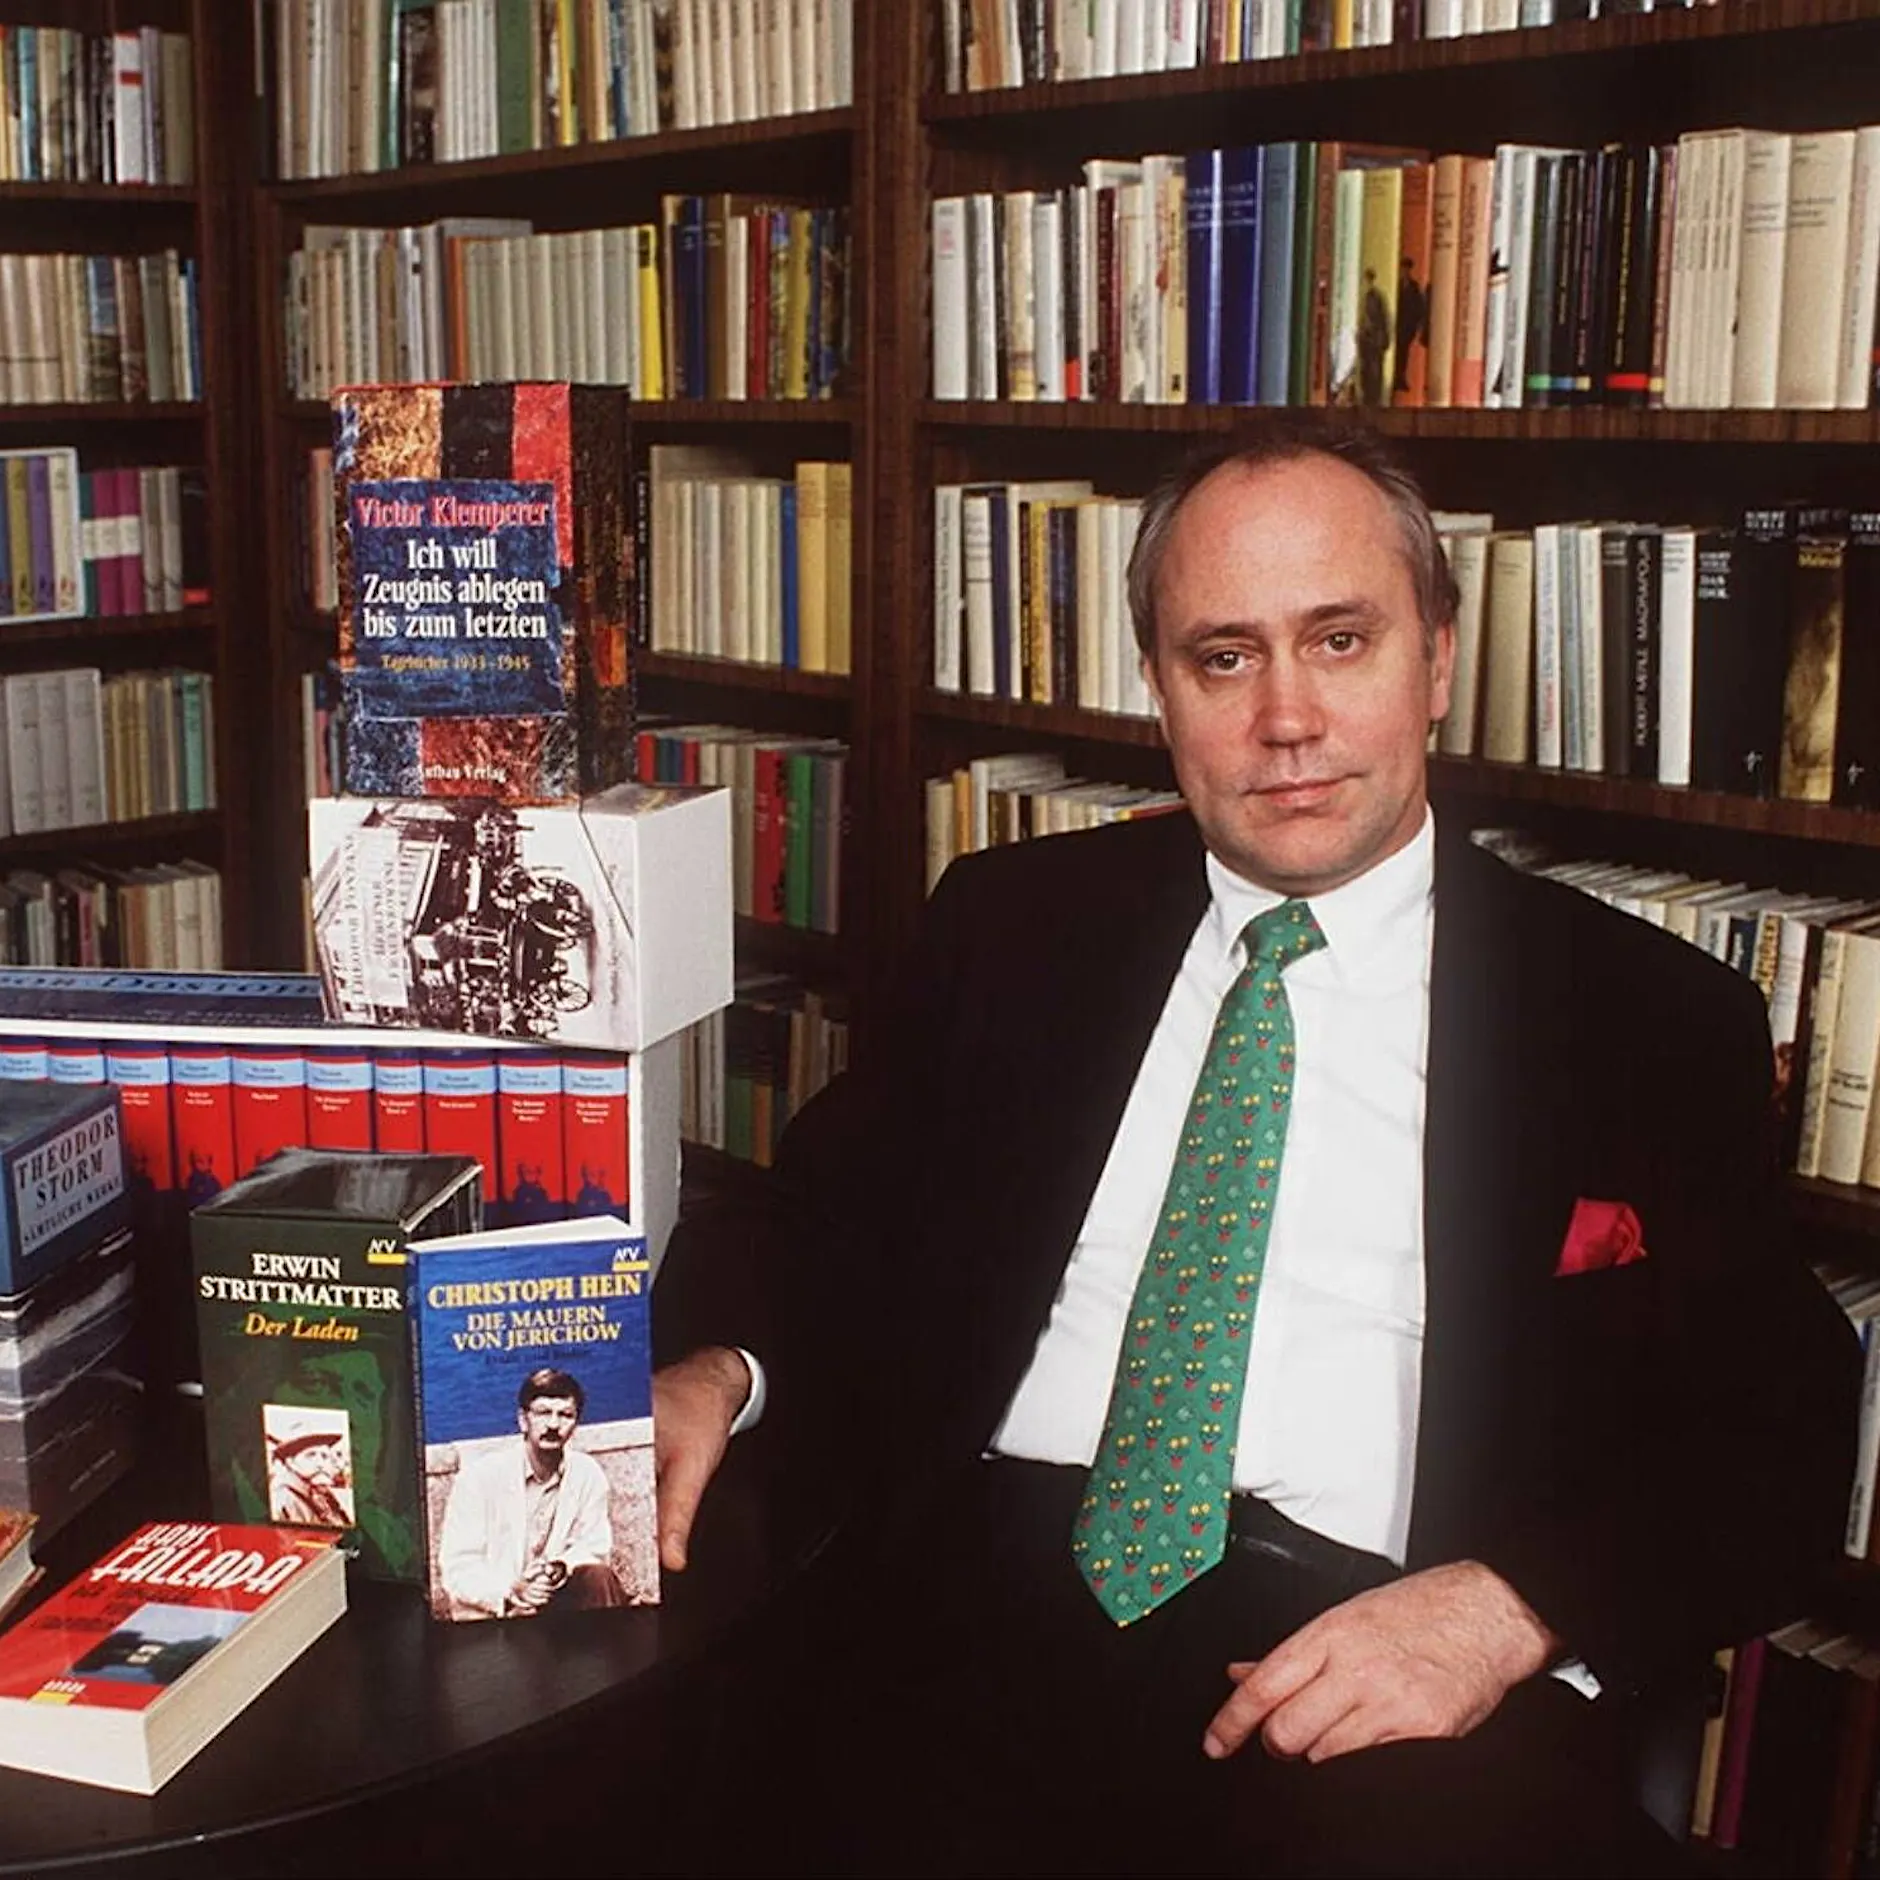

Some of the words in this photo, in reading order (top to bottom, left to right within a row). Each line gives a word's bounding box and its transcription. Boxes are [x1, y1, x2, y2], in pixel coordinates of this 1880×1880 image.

[356, 497, 424, 527] Victor
[432, 496, 548, 534] Klemperer
[407, 538, 444, 569] Ich
[451, 538, 497, 569] will
[363, 570, 452, 611] Zeugnis
[458, 573, 545, 611] ablegen
[364, 607, 397, 638] bis
[405, 614, 457, 638] zum
[465, 607, 546, 638] letzten
[18, 1113, 115, 1191] THEODOR
[36, 1147, 103, 1209] STORM
[252, 1253, 341, 1280] ERWIN
[200, 1276, 402, 1311] STRITTMATTER
[427, 1277, 575, 1309] CHRISTOPH
[580, 1272, 642, 1299] HEIN
[245, 1312, 286, 1336] Der
[291, 1316, 360, 1341] Laden
[467, 1312, 505, 1332] DIE
[512, 1304, 607, 1329] MAUERN
[452, 1332, 503, 1352] VON
[506, 1322, 622, 1351] JERICHOW
[89, 1546, 304, 1596] FALLADA
